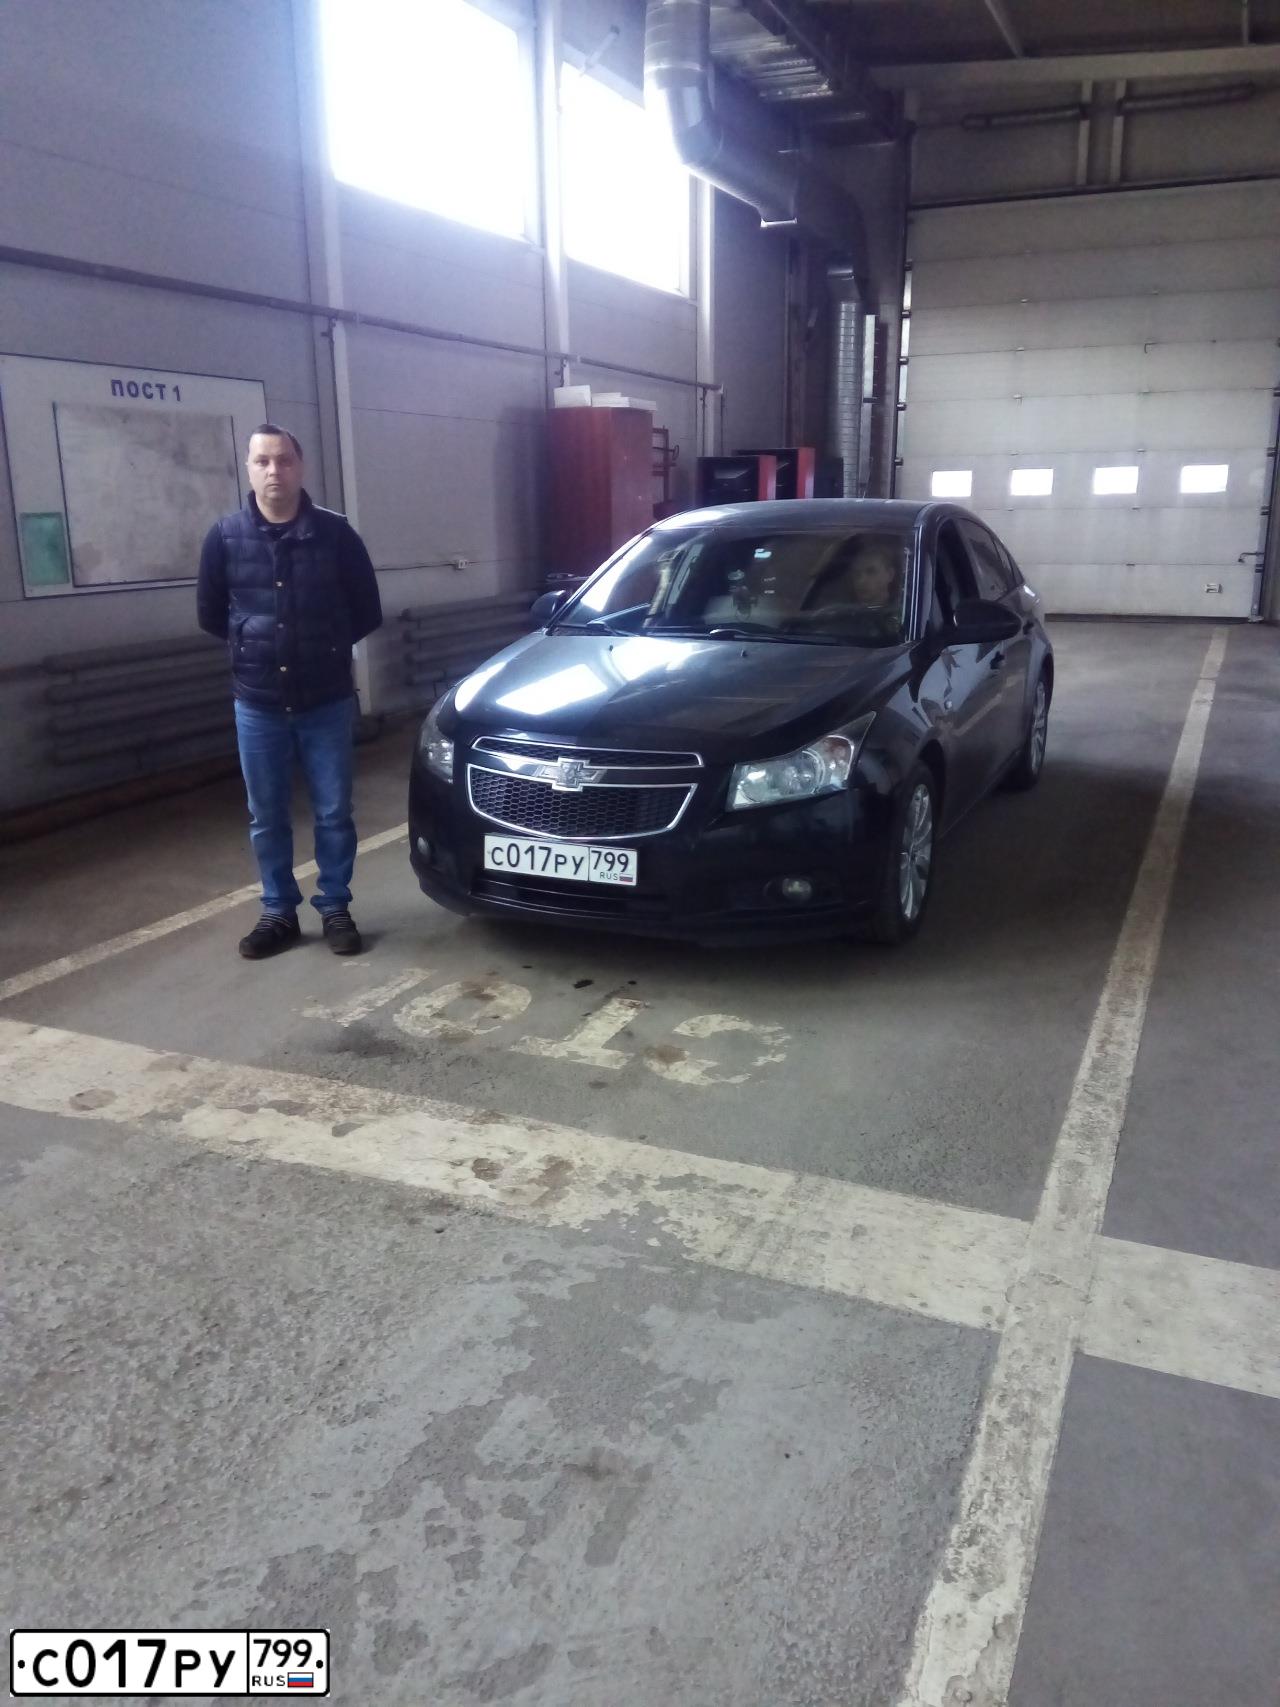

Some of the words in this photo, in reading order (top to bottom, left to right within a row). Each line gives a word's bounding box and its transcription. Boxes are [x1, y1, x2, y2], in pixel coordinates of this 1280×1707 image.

[111, 379, 166, 400] ПОСТ
[172, 384, 181, 402] 1
[491, 843, 585, 876] С017РУ
[591, 850, 630, 873] 799
[600, 872, 619, 881] RUS
